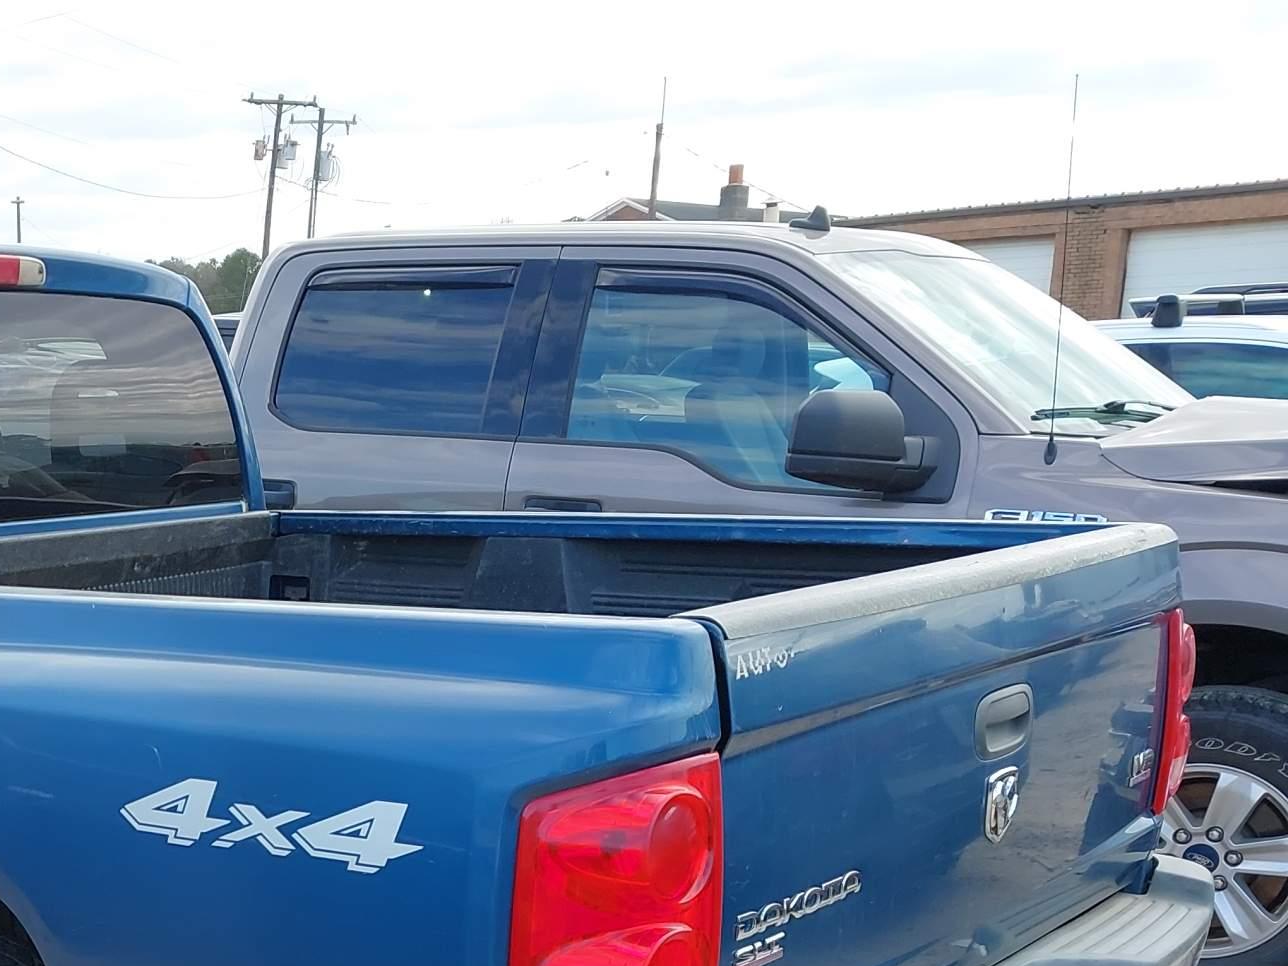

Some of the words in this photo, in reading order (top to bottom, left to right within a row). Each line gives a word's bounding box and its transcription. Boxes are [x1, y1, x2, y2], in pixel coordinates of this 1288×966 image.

[119, 777, 425, 875] 4x4
[734, 869, 862, 942] DAKOTA
[733, 931, 786, 966] SLT
